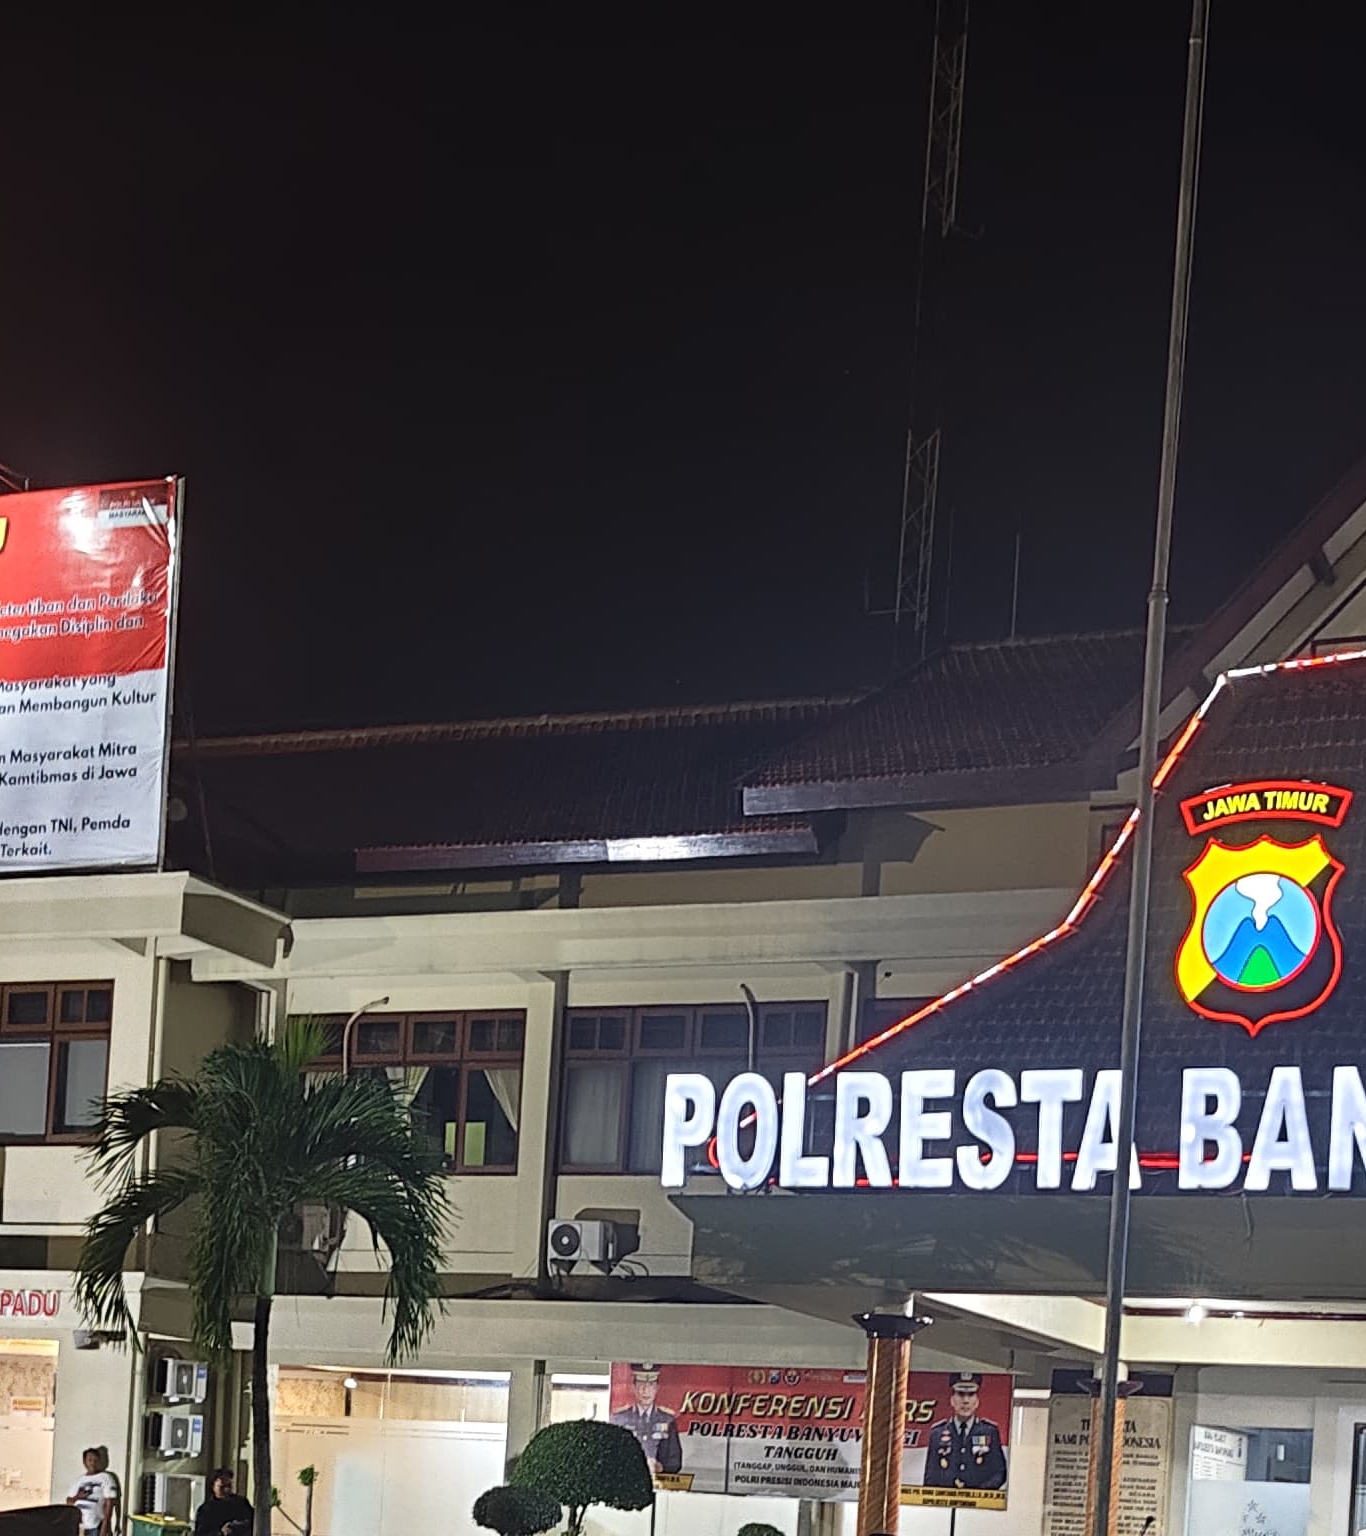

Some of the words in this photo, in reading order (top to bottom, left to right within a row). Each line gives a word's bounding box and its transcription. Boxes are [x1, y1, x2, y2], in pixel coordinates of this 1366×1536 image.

[68, 594, 96, 609] dan
[60, 617, 112, 639] Disiplin
[116, 615, 144, 630] dan
[79, 673, 116, 690] yang
[19, 695, 107, 713] Membangun
[111, 689, 157, 707] Kultur
[9, 745, 95, 765] Masyarakat
[98, 742, 138, 758] Mitra
[81, 765, 95, 781] di
[98, 766, 138, 781] Jawa
[1202, 792, 1261, 821] JAWA
[1263, 791, 1330, 813] TIMUR
[50, 817, 77, 834] TNI,
[81, 813, 131, 831] Pemda
[0, 841, 52, 857] Terkait.
[661, 1068, 1142, 1190] POLRESTA
[680, 1390, 853, 1420] KONFERENSI
[687, 1421, 784, 1440] POLRESTA
[764, 1445, 839, 1461] TANGGUH
[809, 1464, 826, 1474] DAN
[734, 1474, 760, 1485] POLRI
[793, 1476, 840, 1488] INDONESIA
